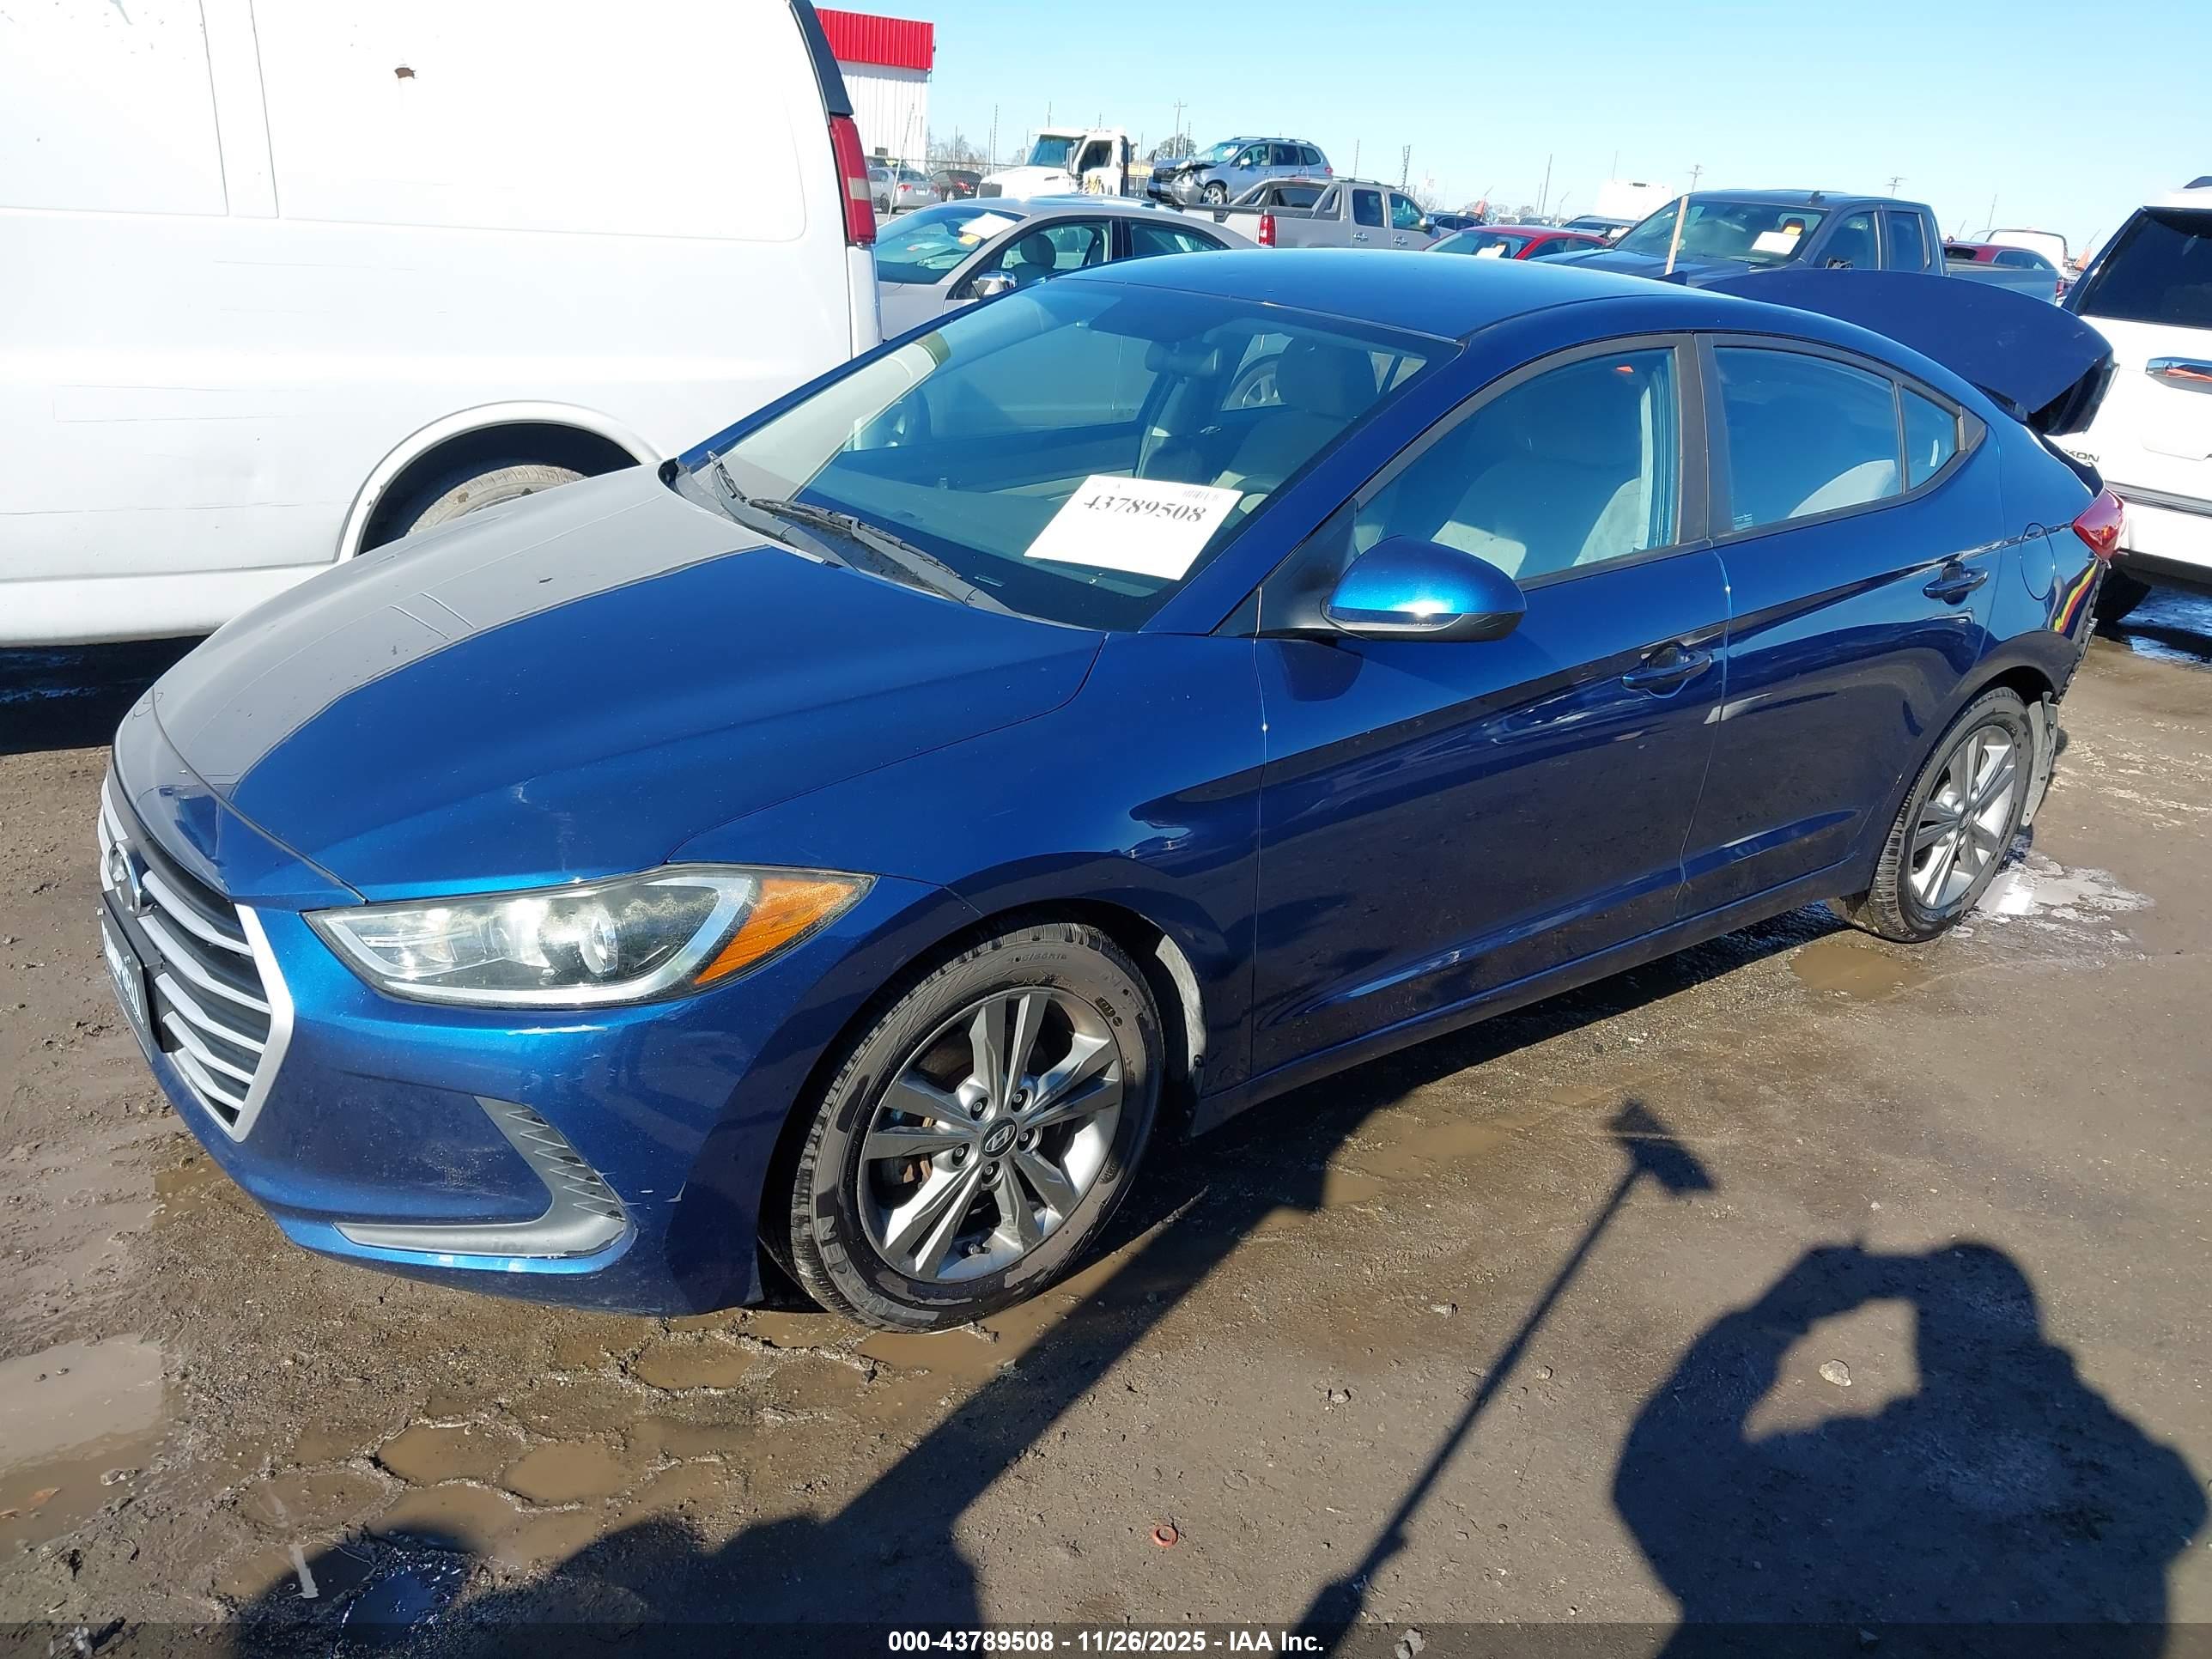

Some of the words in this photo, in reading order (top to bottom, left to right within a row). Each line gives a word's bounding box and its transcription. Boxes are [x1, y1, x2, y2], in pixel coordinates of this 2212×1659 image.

[2063, 448, 2100, 462] KON
[1083, 495, 1207, 523] 43789508
[817, 1215, 895, 1318] NEXEN
